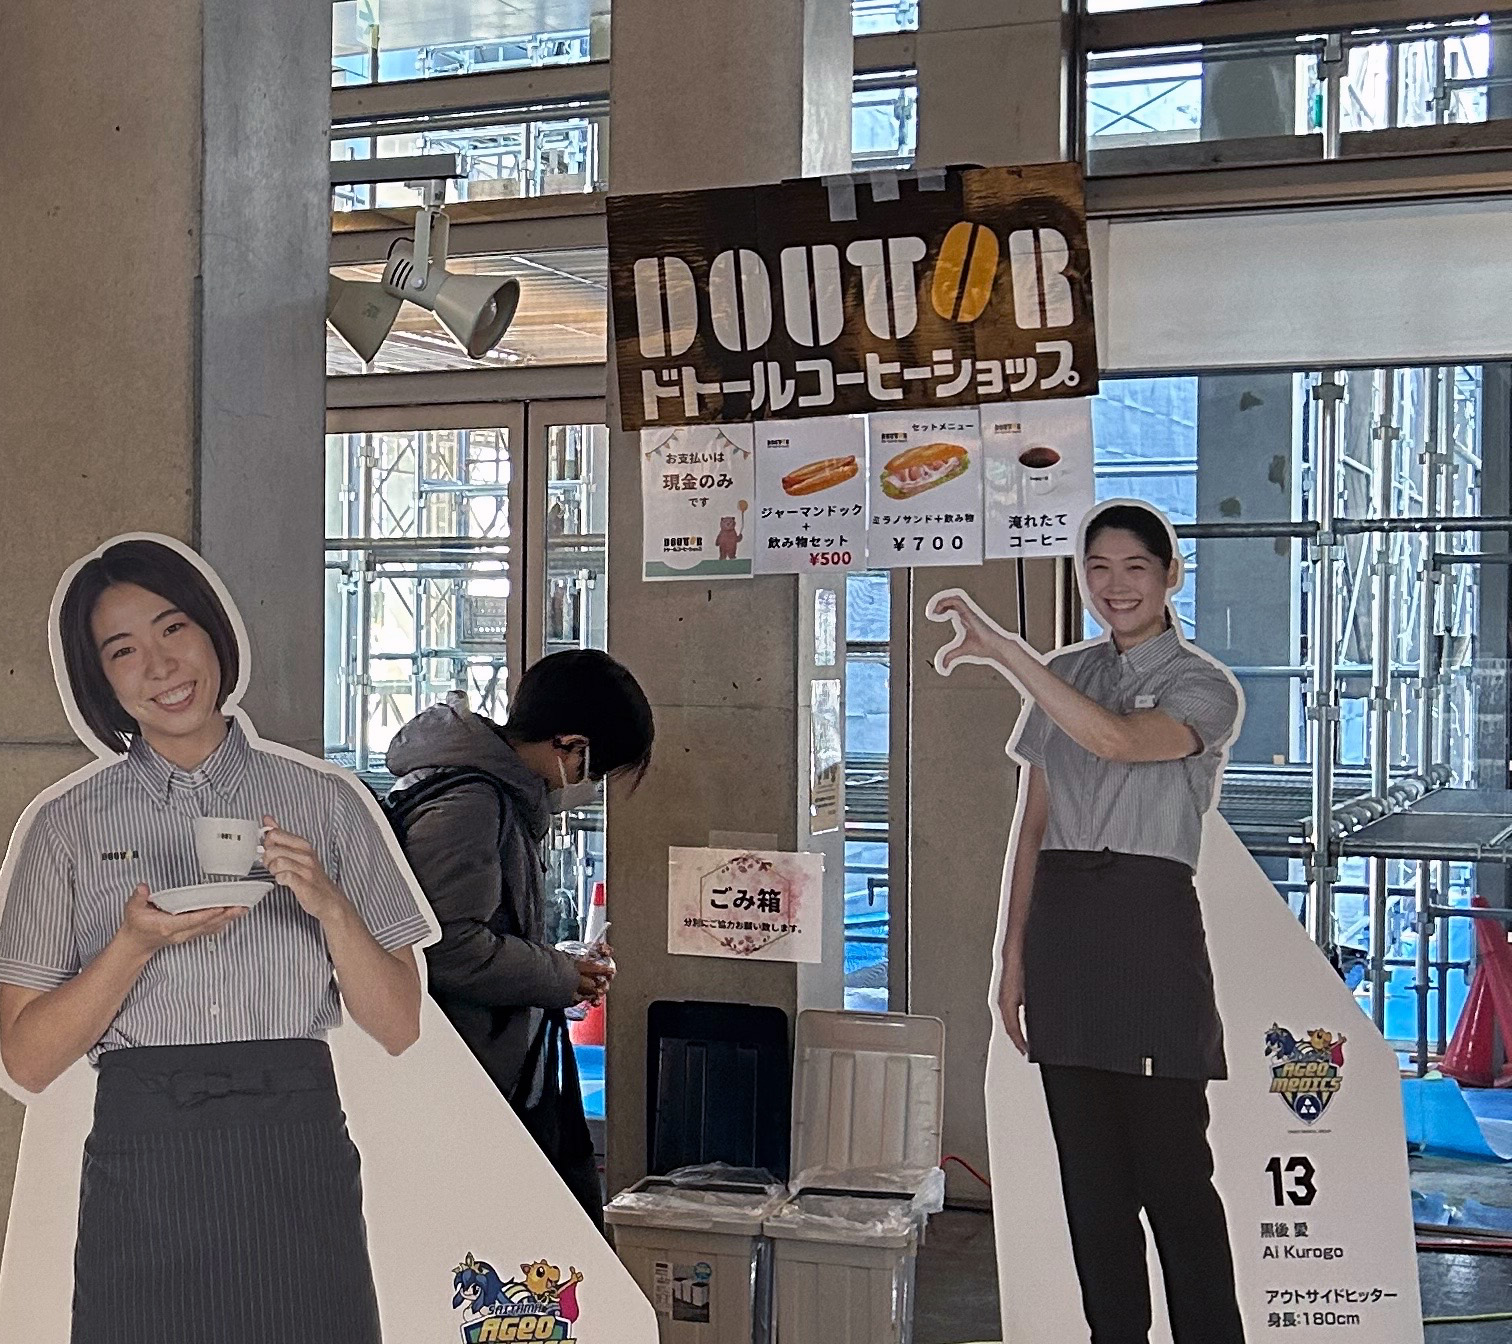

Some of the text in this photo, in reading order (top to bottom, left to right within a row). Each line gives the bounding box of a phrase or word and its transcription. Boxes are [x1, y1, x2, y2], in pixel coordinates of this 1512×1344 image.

[634, 221, 1075, 359] DOUTOR
[641, 340, 1080, 420] ドトールコーヒーショップ
[912, 422, 974, 432] セットメニュー
[665, 452, 725, 464] お支払いは
[662, 473, 734, 491] 現金のみ
[688, 496, 710, 508] です
[761, 503, 863, 519] ジャーマンドック
[767, 534, 848, 549] 飲み物セット
[892, 535, 964, 552] ¥700
[1009, 533, 1068, 548] コーヒー
[809, 551, 852, 566] ¥500
[710, 886, 782, 914] ごみ箱
[1264, 1156, 1318, 1207] 13
[1260, 1222, 1290, 1238] 黒後
[1262, 1245, 1344, 1261] Ai Kurogo
[1265, 1288, 1398, 1305] アウトサイドヒッター
[1267, 1311, 1360, 1328] 身長:180cm
